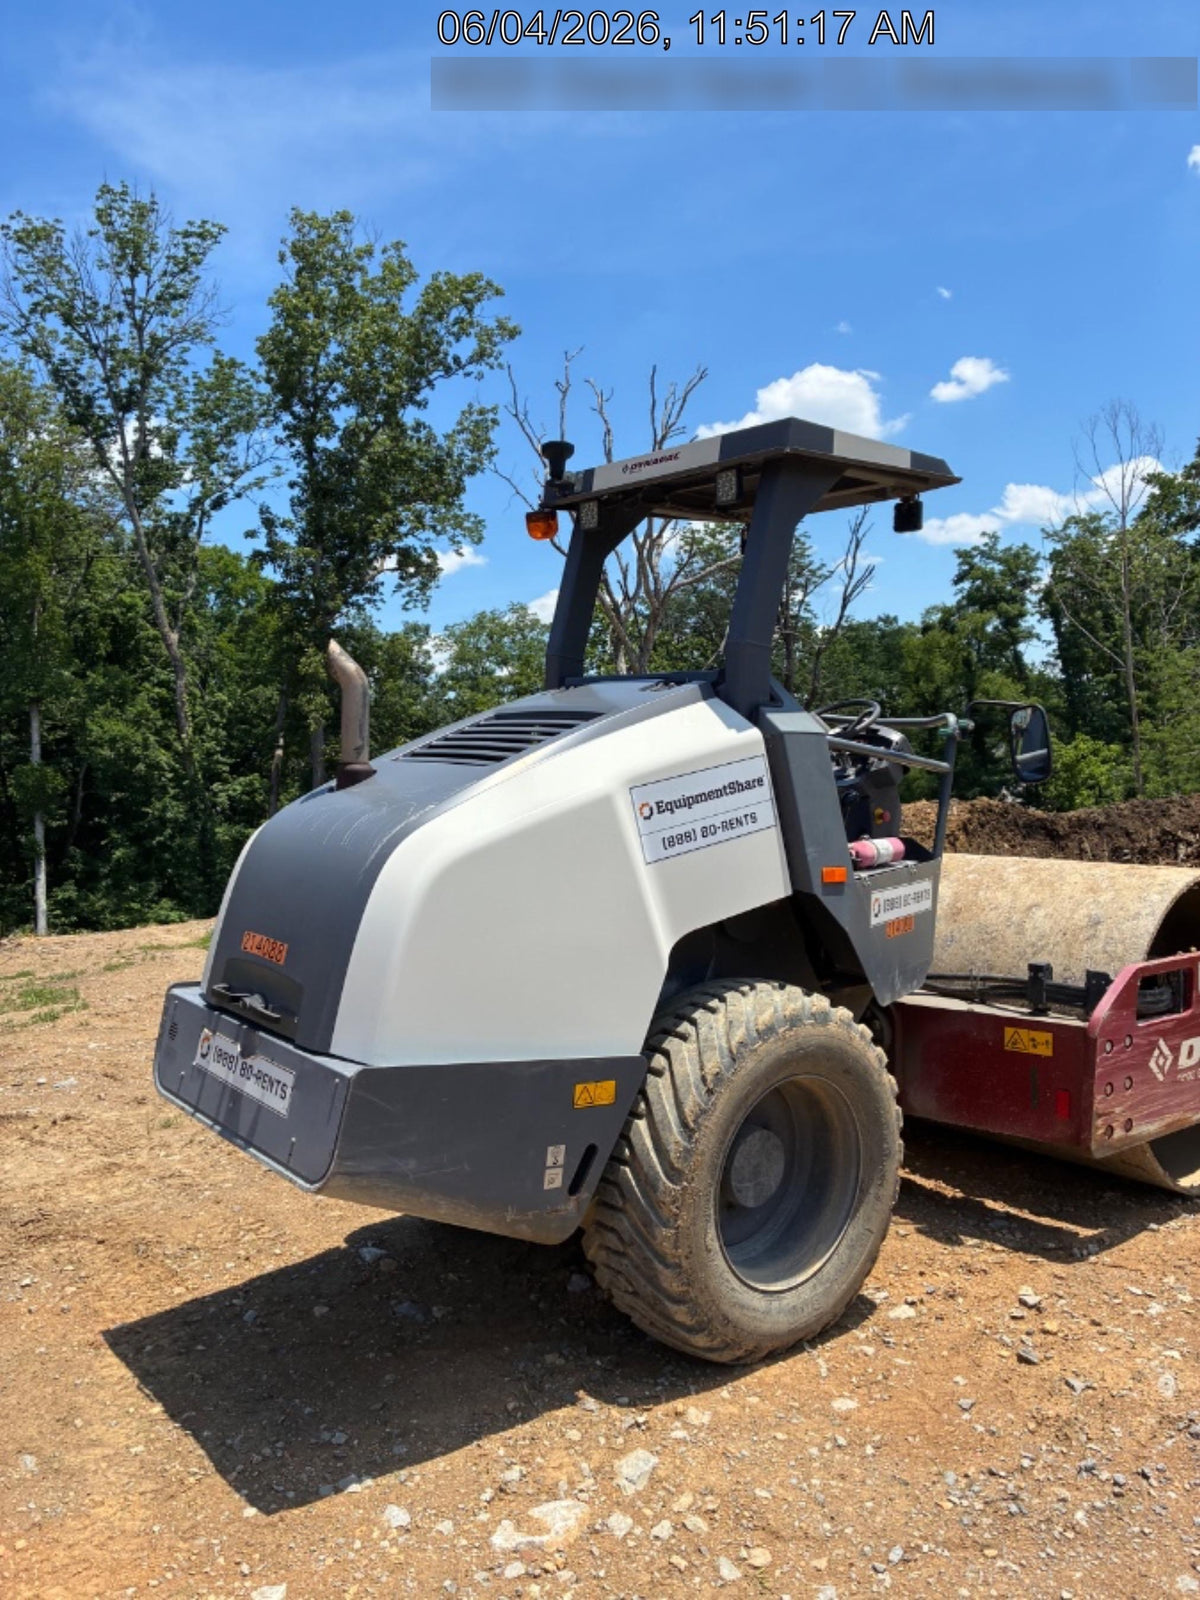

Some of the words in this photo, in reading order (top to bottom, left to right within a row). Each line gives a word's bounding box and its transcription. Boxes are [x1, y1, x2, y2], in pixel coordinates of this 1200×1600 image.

[654, 777, 764, 815] EquipmentShare
[662, 828, 698, 851] (888)
[701, 812, 758, 839] 80-RENTS
[213, 1045, 239, 1075] (888)
[240, 1061, 288, 1100] 80-RENTS
